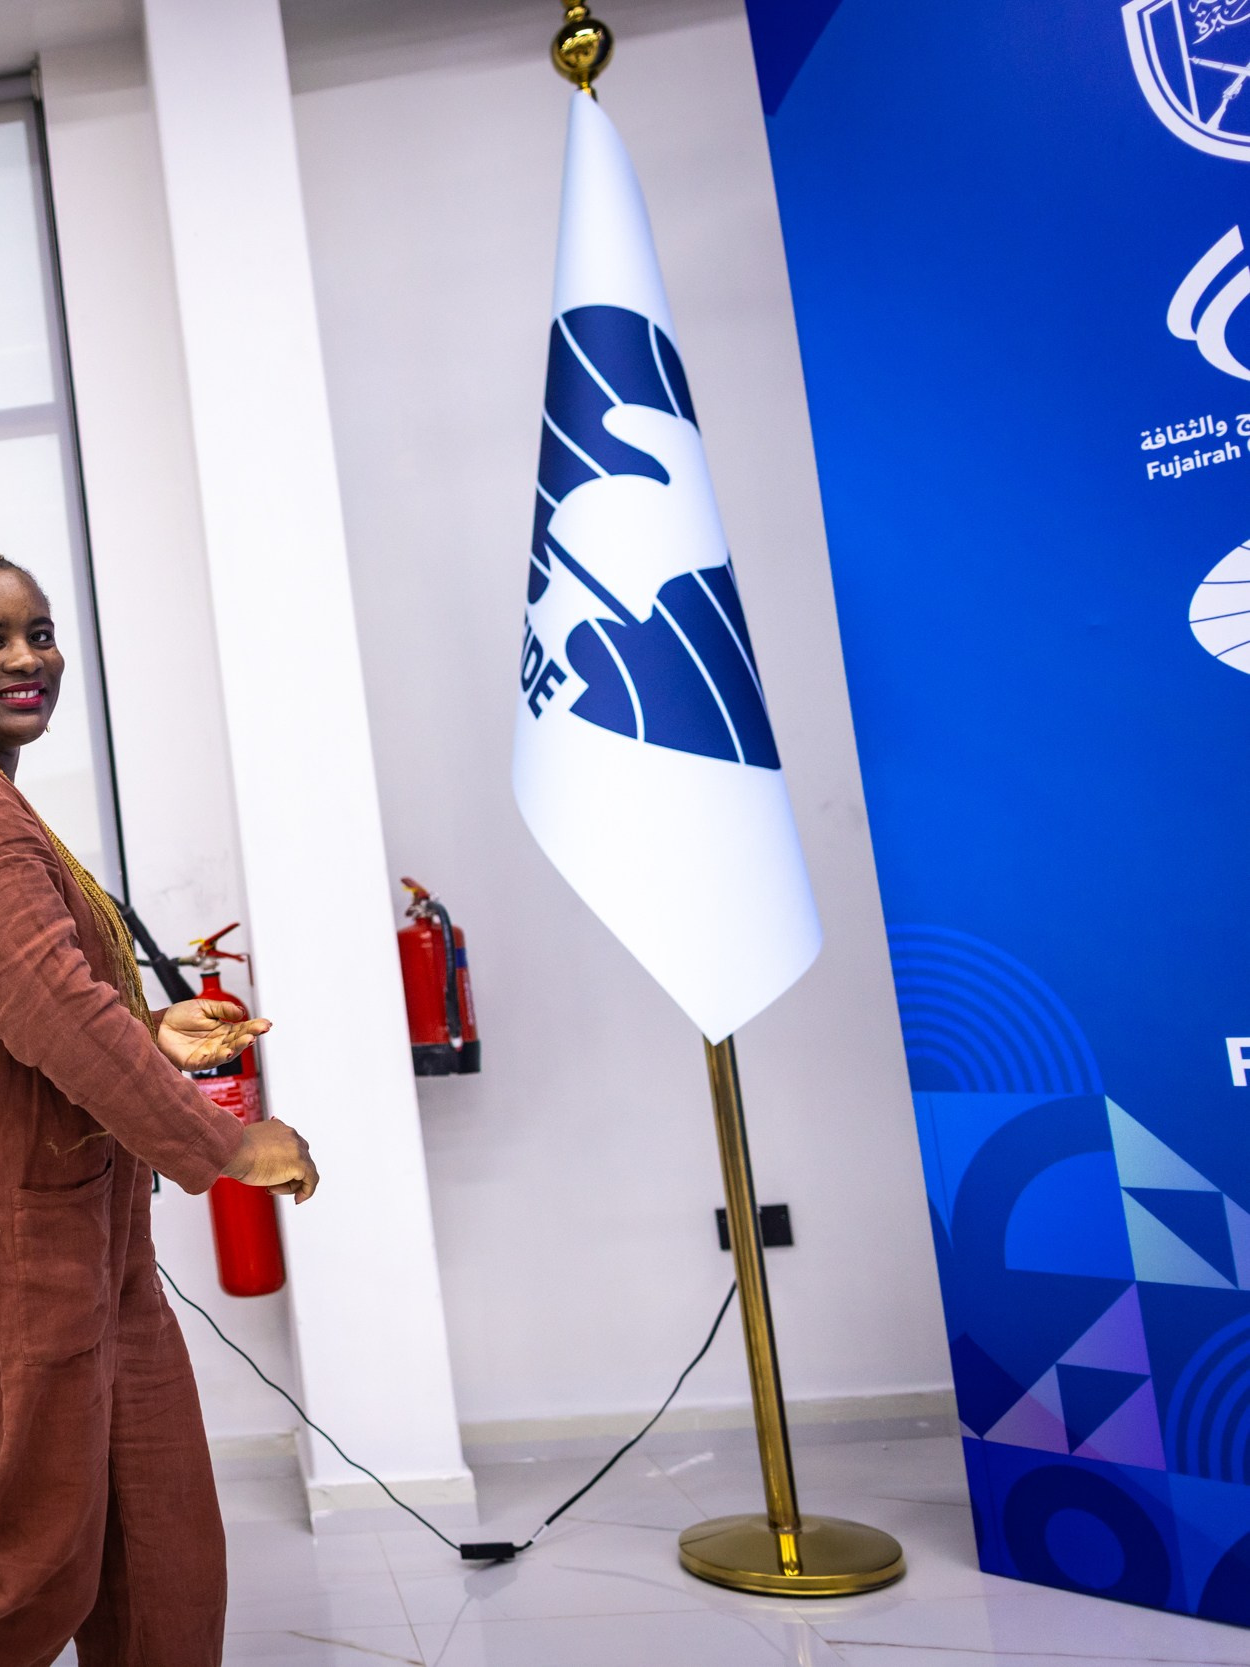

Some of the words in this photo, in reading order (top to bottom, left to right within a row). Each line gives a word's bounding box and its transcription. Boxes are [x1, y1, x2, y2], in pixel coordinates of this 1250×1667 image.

[1140, 414, 1228, 451] والثقافة
[1146, 441, 1241, 480] Fujairah
[520, 608, 568, 720] IDE
